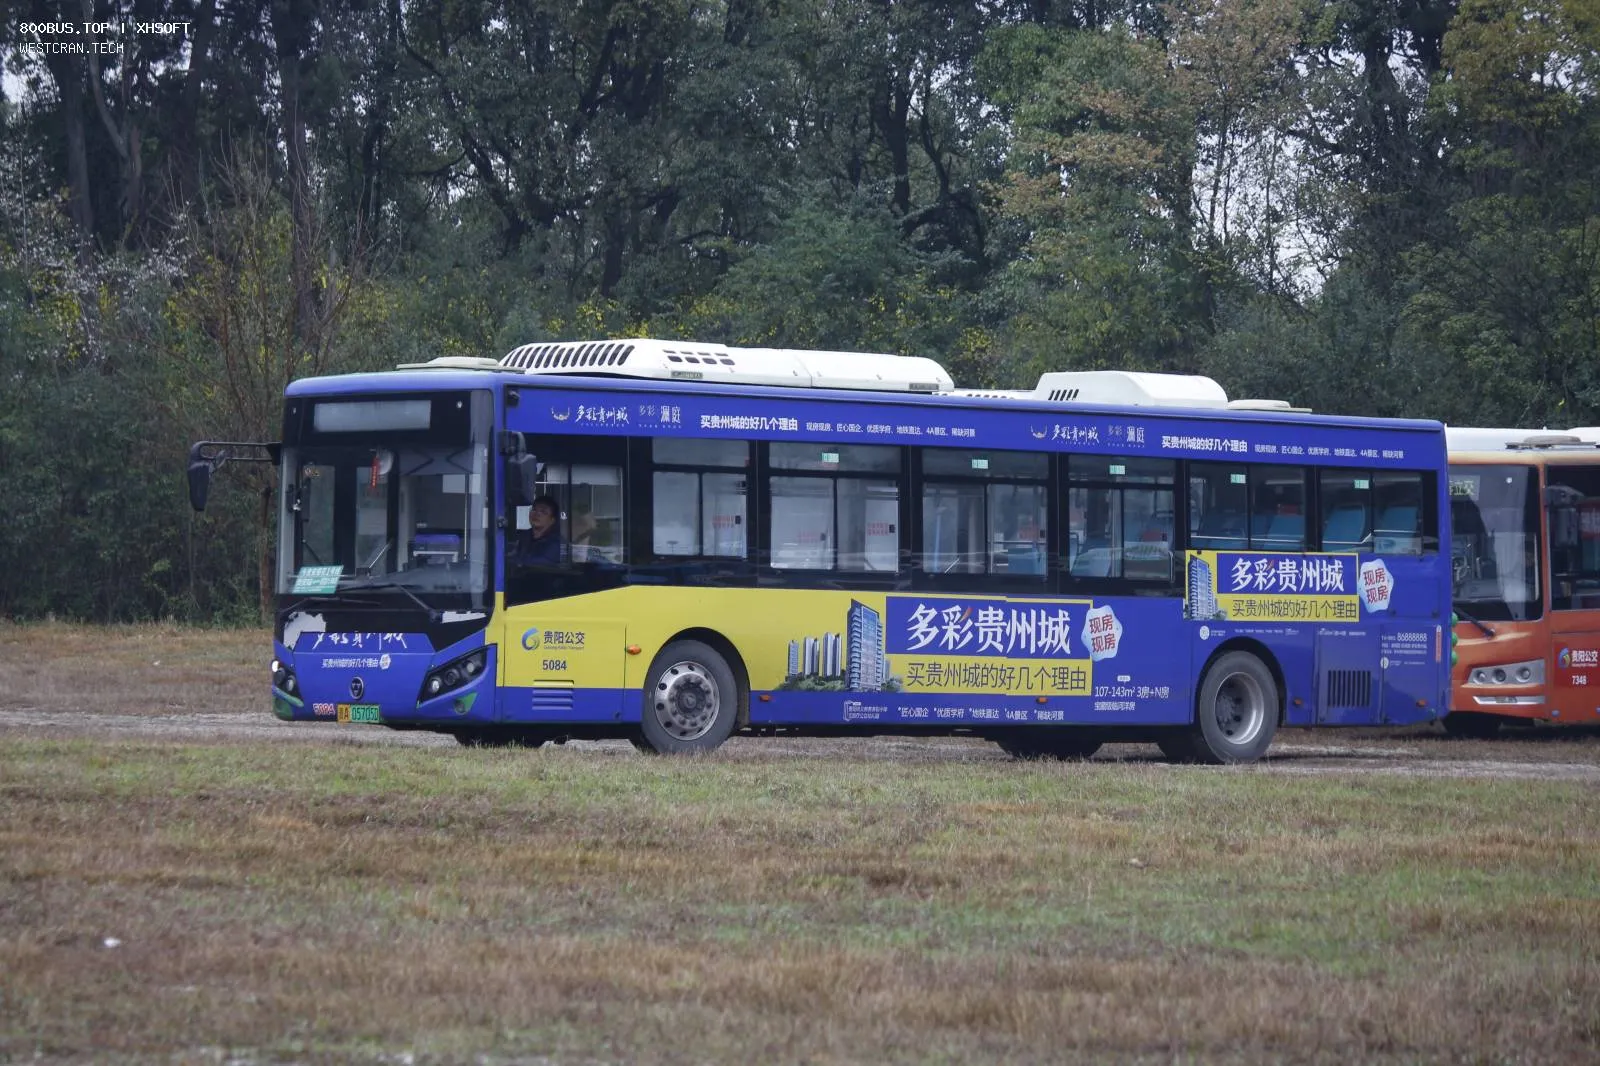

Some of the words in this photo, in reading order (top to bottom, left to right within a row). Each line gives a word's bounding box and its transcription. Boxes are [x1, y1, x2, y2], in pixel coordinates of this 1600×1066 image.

[700, 414, 798, 431] 买贵州城的好几个理由
[1161, 435, 1248, 453] 买贵州城的好几个理由
[1231, 557, 1344, 593] 多彩贵州城
[1363, 567, 1386, 585] 现房
[1366, 585, 1388, 603] 现房
[1232, 599, 1357, 619] 买贵州城的好几个理由
[906, 603, 1071, 655] 多彩贵州城
[1088, 613, 1114, 634] 现房
[543, 631, 585, 645] 贵阳公交
[1091, 633, 1116, 653] 现房
[542, 659, 567, 671] 5084
[1572, 650, 1598, 662] 贵阳公交
[906, 661, 1086, 692] 买贵州城的好几个理由
[901, 707, 929, 718] 匠心国企
[937, 708, 965, 719] 优质学府
[972, 709, 1000, 719] 地铁直达
[1006, 711, 1028, 720] 4A景区
